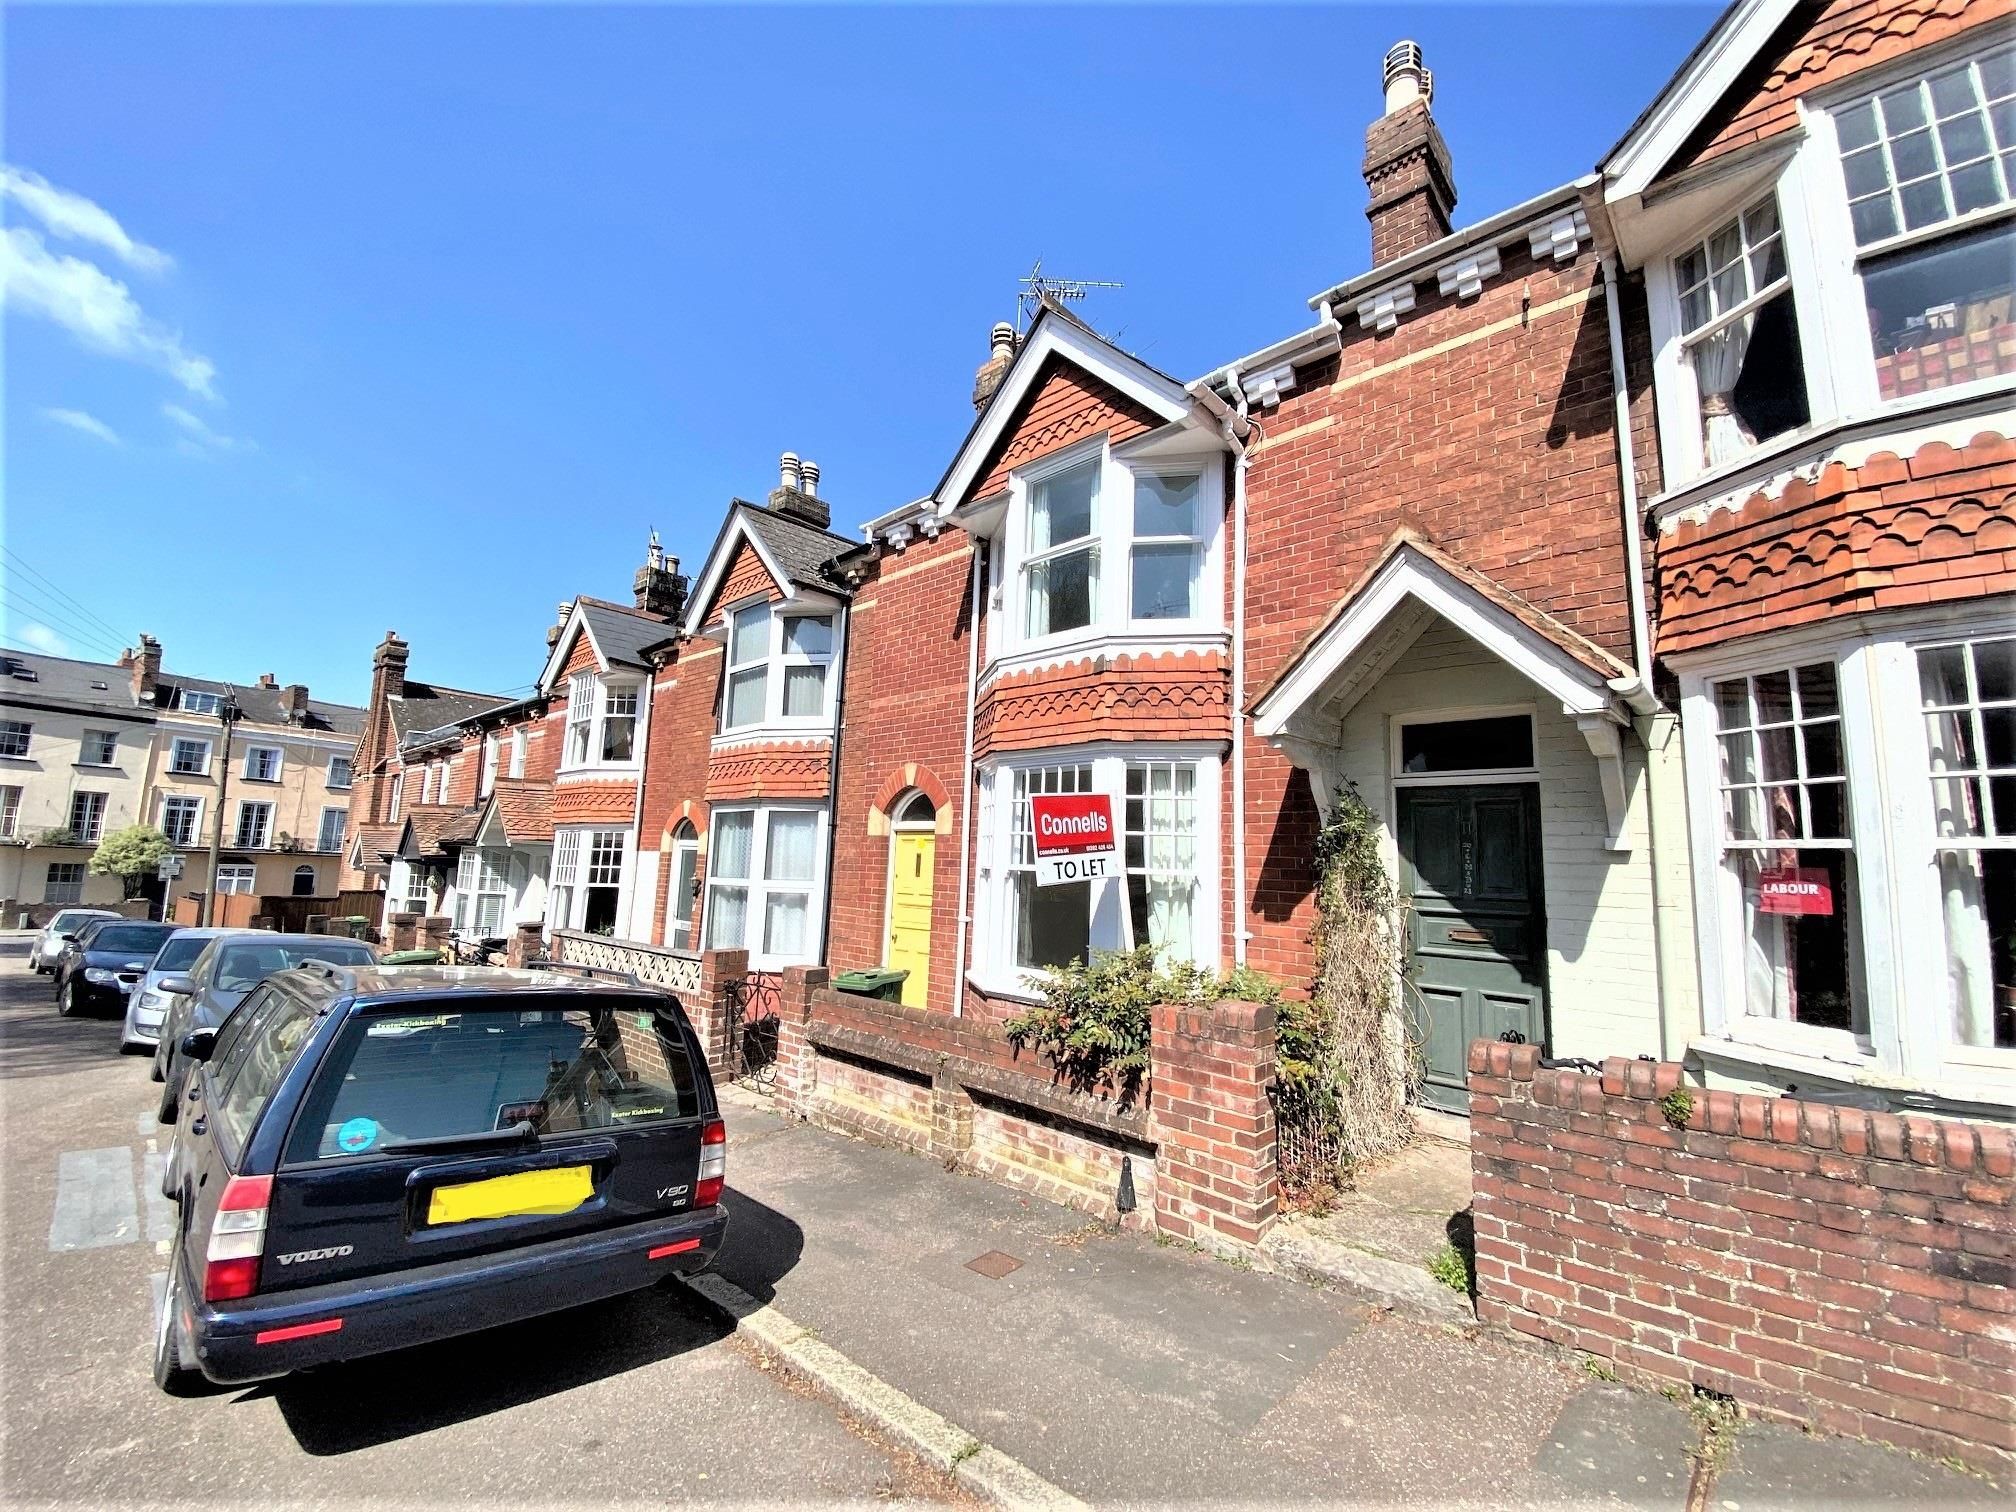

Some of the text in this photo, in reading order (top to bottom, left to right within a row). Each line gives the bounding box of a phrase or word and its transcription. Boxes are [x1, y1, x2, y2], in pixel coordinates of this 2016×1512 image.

[1041, 811, 1108, 836] Connells
[1039, 847, 1070, 856] connells.co.uk
[1053, 858, 1106, 880] TO LET
[1763, 883, 1820, 895] LABOUR
[631, 1107, 664, 1116] Kickboxing
[656, 1184, 689, 1200] V90
[276, 1245, 354, 1266] VOLVO
